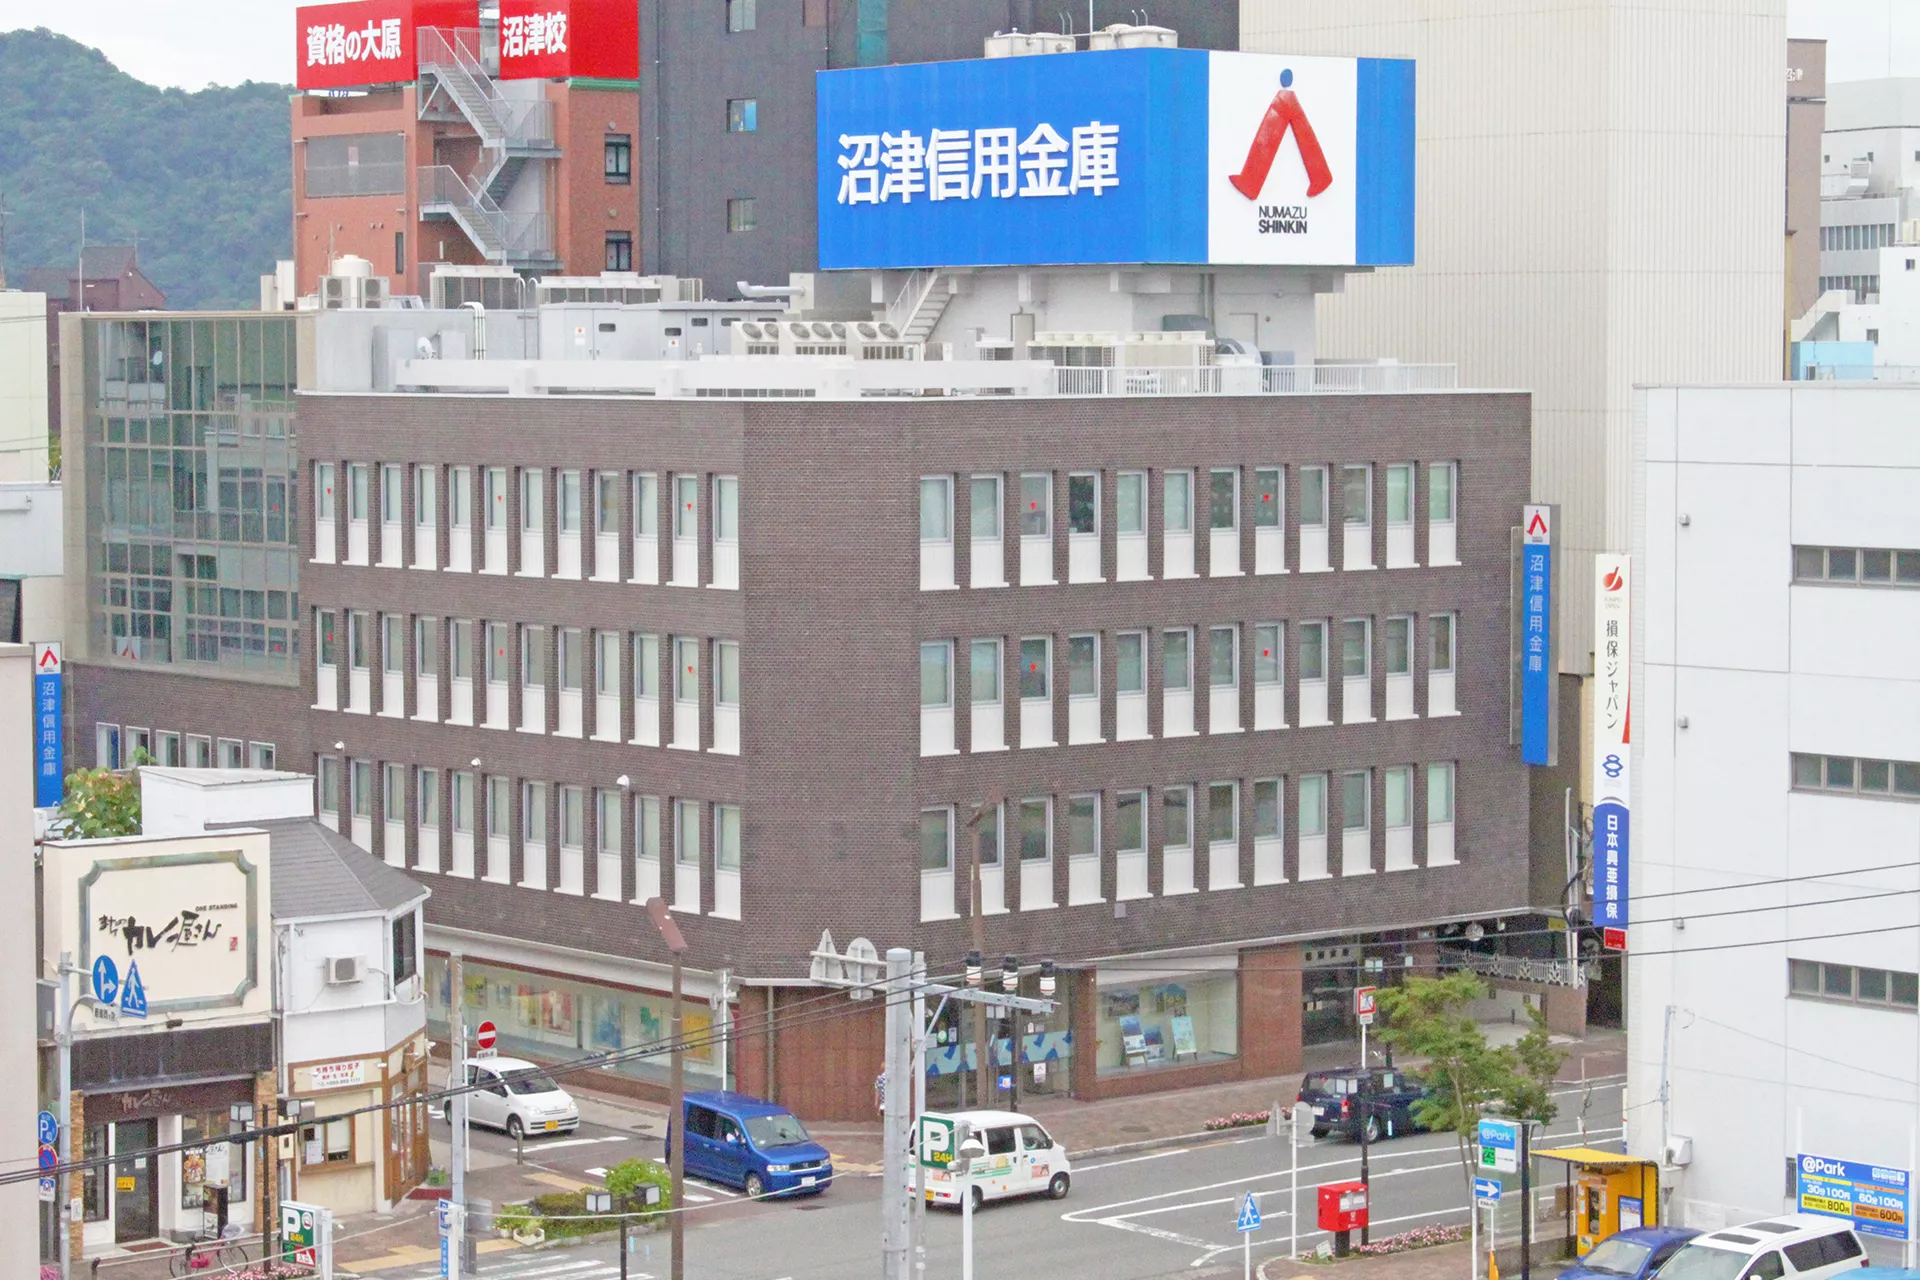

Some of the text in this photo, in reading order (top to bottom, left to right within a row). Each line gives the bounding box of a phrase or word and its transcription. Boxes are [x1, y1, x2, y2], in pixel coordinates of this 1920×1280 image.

[306, 18, 401, 67] 資格の大原
[503, 11, 567, 58] 沼津校
[837, 120, 1120, 205] 沼津信用金庫
[1258, 205, 1307, 219] NUMAZU
[1258, 219, 1308, 234] SHINKIN
[1528, 554, 1544, 672] 沼津信用金庫
[1606, 620, 1619, 730] 損保ジャパン
[42, 682, 57, 776] 沼津信用金庫
[1606, 815, 1618, 919] 日本興亜損保
[923, 1120, 950, 1161] P
[1482, 1127, 1511, 1142] @Park
[933, 1151, 953, 1163] 24H
[1802, 1156, 1846, 1177] @Park
[282, 1207, 301, 1240] P
[1827, 1200, 1850, 1214] 800円
[1880, 1211, 1903, 1223] 600円
